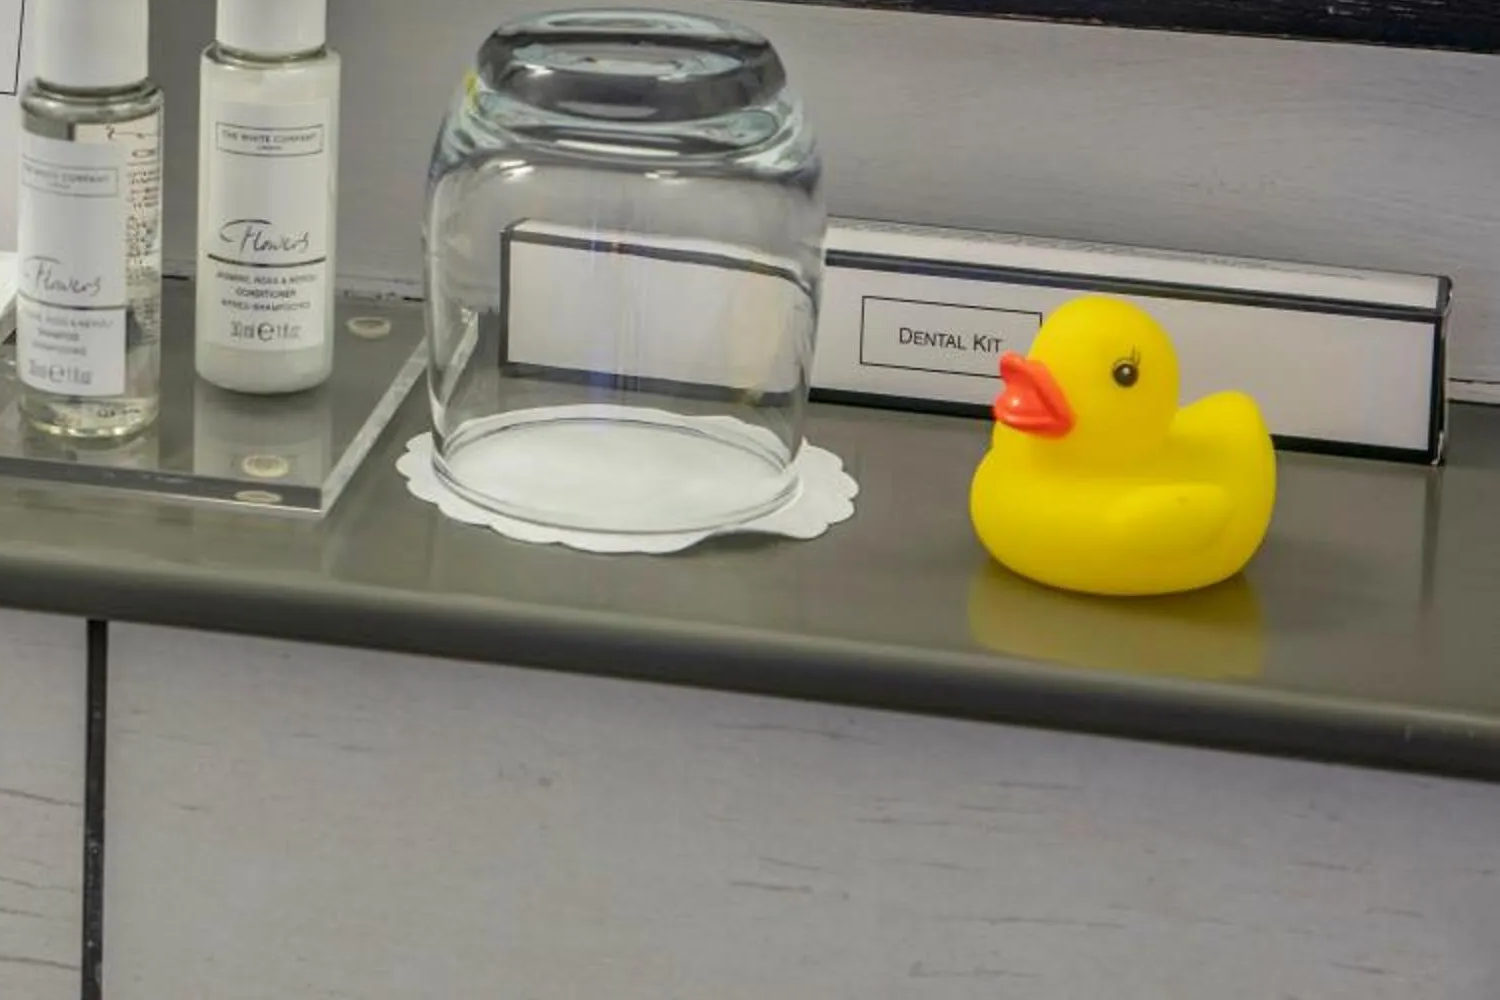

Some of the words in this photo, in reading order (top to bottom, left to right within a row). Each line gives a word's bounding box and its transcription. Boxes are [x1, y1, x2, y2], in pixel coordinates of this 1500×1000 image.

[217, 218, 312, 253] Flowers
[24, 256, 103, 297] Flowers
[899, 327, 966, 350] DENTAL
[973, 334, 1004, 353] KIT
